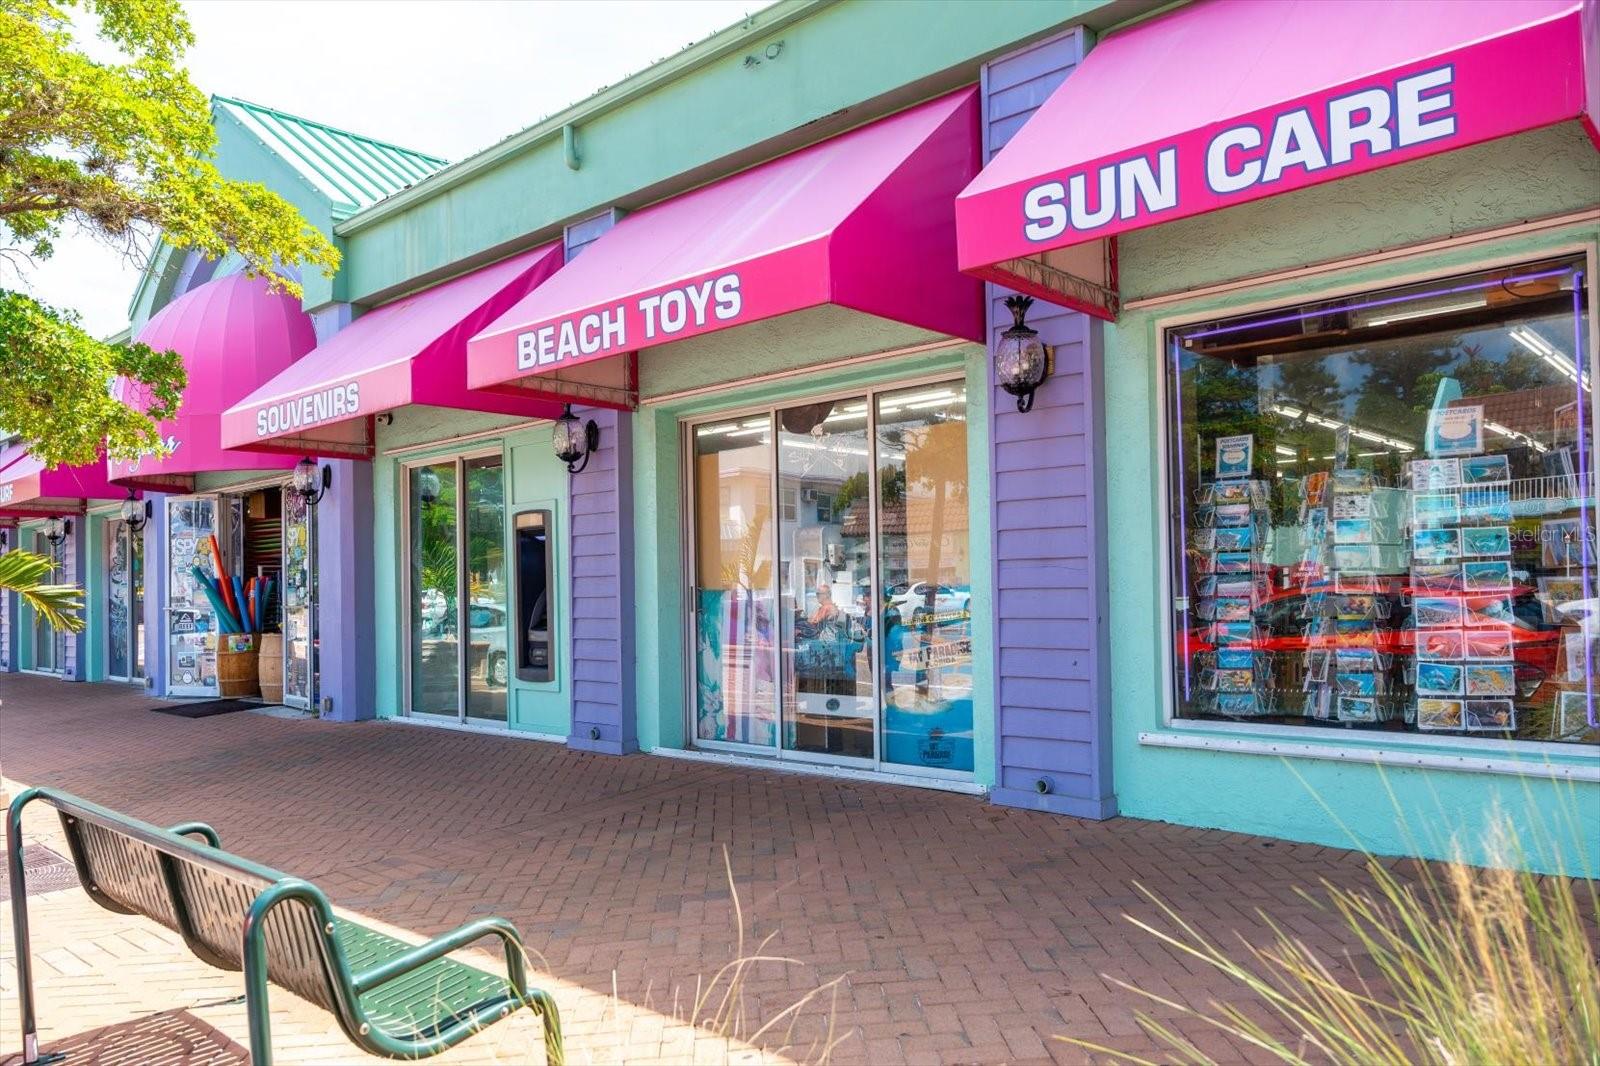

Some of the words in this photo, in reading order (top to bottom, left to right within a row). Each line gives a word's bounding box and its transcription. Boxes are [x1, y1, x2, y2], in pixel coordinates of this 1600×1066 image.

[1023, 144, 1177, 242] SUN
[1204, 63, 1456, 194] CARE
[516, 304, 626, 371] BEACH
[639, 273, 741, 338] TOYS
[256, 381, 359, 436] SOUVENIRS
